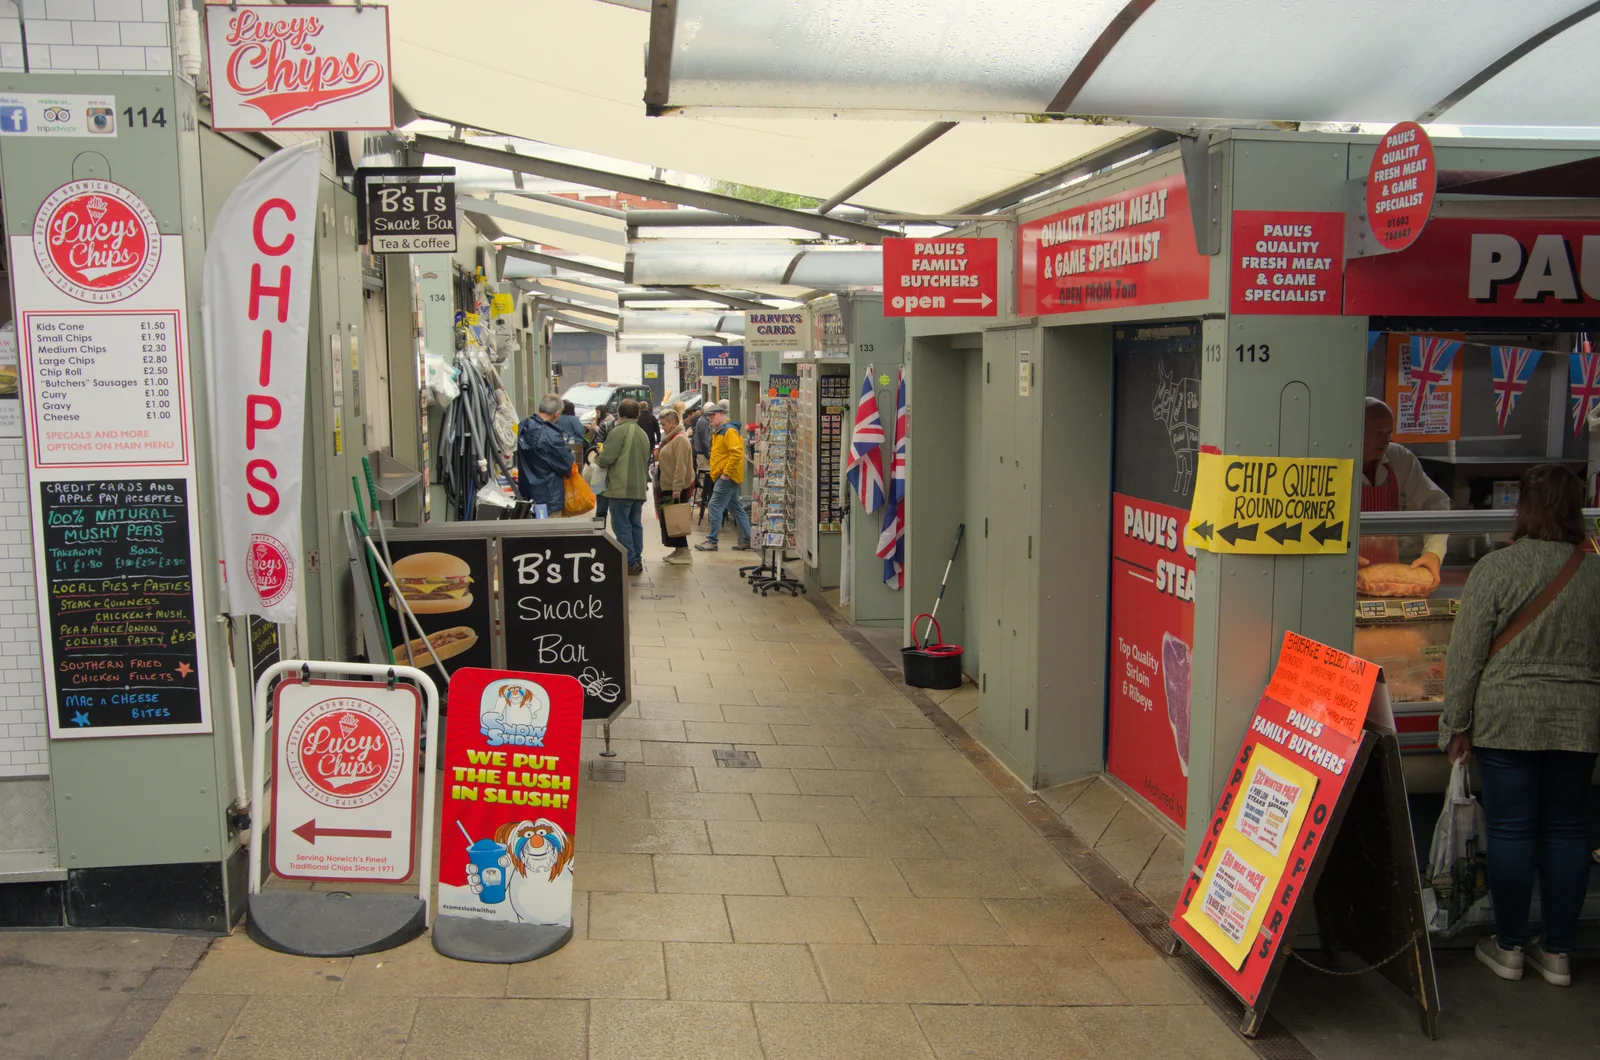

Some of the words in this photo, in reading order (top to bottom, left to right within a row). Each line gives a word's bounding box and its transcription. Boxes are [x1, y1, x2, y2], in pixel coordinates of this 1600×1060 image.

[225, 9, 324, 46] Lucys
[226, 39, 376, 98] Chips
[123, 107, 167, 128] 114
[37, 124, 76, 133] tripadvisor
[1386, 128, 1416, 149] PAUL'S
[1382, 143, 1420, 166] QUALITY
[1374, 165, 1400, 184] FRESH
[1402, 158, 1427, 176] MEAT
[1382, 184, 1390, 197] &
[1392, 177, 1418, 194] GAME
[377, 185, 416, 213] B's
[416, 185, 448, 213] T's
[1376, 192, 1424, 214] SPECIALIST
[374, 217, 421, 231] Snack
[424, 214, 454, 230] Bar
[1041, 213, 1086, 248] QUALITY
[1088, 202, 1125, 237] FRESH
[1128, 188, 1168, 226] MEAT
[52, 212, 139, 250] Lucys
[1264, 224, 1312, 238] PAUL'S
[378, 238, 400, 249] Tea
[402, 239, 411, 248] &
[413, 238, 450, 249] Coffee
[914, 243, 966, 256] PAUL'S
[1256, 240, 1320, 254] QUALITY
[69, 242, 136, 268] Chips
[1044, 256, 1053, 280] &
[1055, 248, 1086, 278] GAME
[1088, 230, 1161, 273] SPECIALIST
[912, 259, 969, 272] FAMILY
[1242, 256, 1288, 270] FRESH
[1292, 258, 1332, 270] MEAT
[900, 275, 980, 288] BUTCHERS
[1256, 273, 1268, 286] &
[1272, 273, 1316, 286] GAME
[429, 294, 446, 302] 134
[1060, 286, 1082, 306] OPEN
[1085, 281, 1112, 302] FROM
[1244, 288, 1327, 302] SPECIALIST
[892, 296, 946, 313] open
[750, 314, 802, 324] HARVEYS
[36, 322, 56, 332] Kids
[58, 323, 85, 331] Cone
[140, 322, 166, 330] £1.50
[757, 325, 796, 336] CARDS
[36, 334, 63, 342] Small
[66, 334, 93, 344] Chips
[141, 333, 166, 342] £1.90
[38, 345, 78, 354] Medium
[80, 344, 107, 355] Chips
[142, 344, 167, 352] £2.30
[859, 344, 874, 352] 133
[1206, 344, 1221, 362] 113
[1236, 344, 1270, 362] 113
[38, 356, 66, 366] Large
[68, 356, 96, 366] Chips
[142, 356, 168, 364] £2.80
[246, 198, 296, 516] CHIPS
[40, 368, 62, 378] Chip
[65, 368, 82, 376] Roll
[144, 366, 168, 376] £2.50
[40, 379, 90, 388] "Butchers"
[92, 378, 138, 390] Sausages
[144, 378, 169, 386] £1.00
[771, 377, 798, 386] SALMON
[42, 391, 68, 400] Curry
[144, 389, 170, 398] £1.00
[42, 402, 72, 412] Gravy
[146, 400, 170, 408] £1.00
[44, 412, 80, 422] Cheese
[146, 412, 171, 420] £1.00
[46, 431, 92, 440] SPECIALS
[94, 430, 118, 439] AND
[120, 430, 150, 438] MORE
[46, 442, 92, 452] OPTIONS
[95, 442, 112, 450] ON
[114, 442, 142, 450] MAIN
[144, 441, 174, 450] MENU
[1224, 461, 1278, 496] CHIP
[1282, 463, 1338, 498] QUEUE
[46, 483, 96, 494] CREDIT
[100, 483, 143, 492] CARDS
[150, 482, 175, 492] AND
[60, 494, 93, 503] APPLE
[99, 493, 119, 505] PAY
[125, 494, 184, 503] ACCEPTED
[1233, 496, 1284, 520] ROUND
[1285, 500, 1336, 520] CORNER
[48, 509, 85, 526] 100%
[96, 508, 174, 522] NATURAL
[64, 526, 120, 540] MUSHY
[126, 524, 164, 537] PEAS
[1124, 505, 1178, 552] PAUL'S
[49, 547, 102, 558] TAKEAWAY
[128, 545, 163, 556] BOWL
[512, 549, 562, 585] B's
[564, 548, 606, 584] T's
[52, 582, 96, 594] LOCAL
[102, 580, 129, 592] PIES
[143, 579, 192, 592] PASTIES
[60, 600, 92, 610] STEAK
[104, 598, 160, 608] GUINNESS
[517, 594, 604, 621] Snack
[96, 612, 144, 622] CHICKEN
[60, 625, 80, 634] PEA
[90, 622, 158, 636] MINCE/ONION
[66, 637, 118, 647] CORNISH
[126, 636, 164, 646] PASTY
[532, 633, 590, 664] Bar
[1118, 636, 1131, 659] Top
[1132, 644, 1160, 675] Quality
[1286, 633, 1322, 660] SAUSAGE
[1324, 647, 1367, 676] SELECTION
[60, 660, 124, 672] SOUTHERN
[130, 660, 162, 668] FRIED
[72, 674, 120, 684] CHICKEN
[130, 672, 174, 682] FILLETS
[1126, 662, 1150, 688] Sirloin
[66, 695, 94, 707] MAC
[112, 693, 159, 704] CHEESE
[1128, 684, 1153, 712] Ribeye
[132, 708, 170, 719] BITES
[1286, 709, 1324, 738] PAUL'S
[304, 726, 385, 760] Lucys
[1252, 715, 1291, 746] FAMILY
[1288, 732, 1346, 776] BUTCHERS
[318, 752, 377, 777] Chips
[466, 749, 508, 768] WE
[512, 753, 560, 772] PUT
[452, 766, 502, 785] THE
[506, 770, 572, 792] LUSH
[452, 784, 479, 802] IN
[482, 787, 570, 810] SLUSH!
[1144, 774, 1176, 814] Matured
[1176, 803, 1184, 818] to
[296, 854, 325, 863] Serving
[326, 854, 364, 864] Norwich's
[365, 856, 388, 864] Finest
[289, 862, 329, 870] Traditional
[330, 864, 353, 872] Chips
[354, 864, 376, 872] Since
[378, 865, 395, 873] 1971
[1246, 868, 1266, 892] PACK
[1258, 804, 1327, 959] OFFERS
[442, 902, 497, 915] #comeslushwithus
